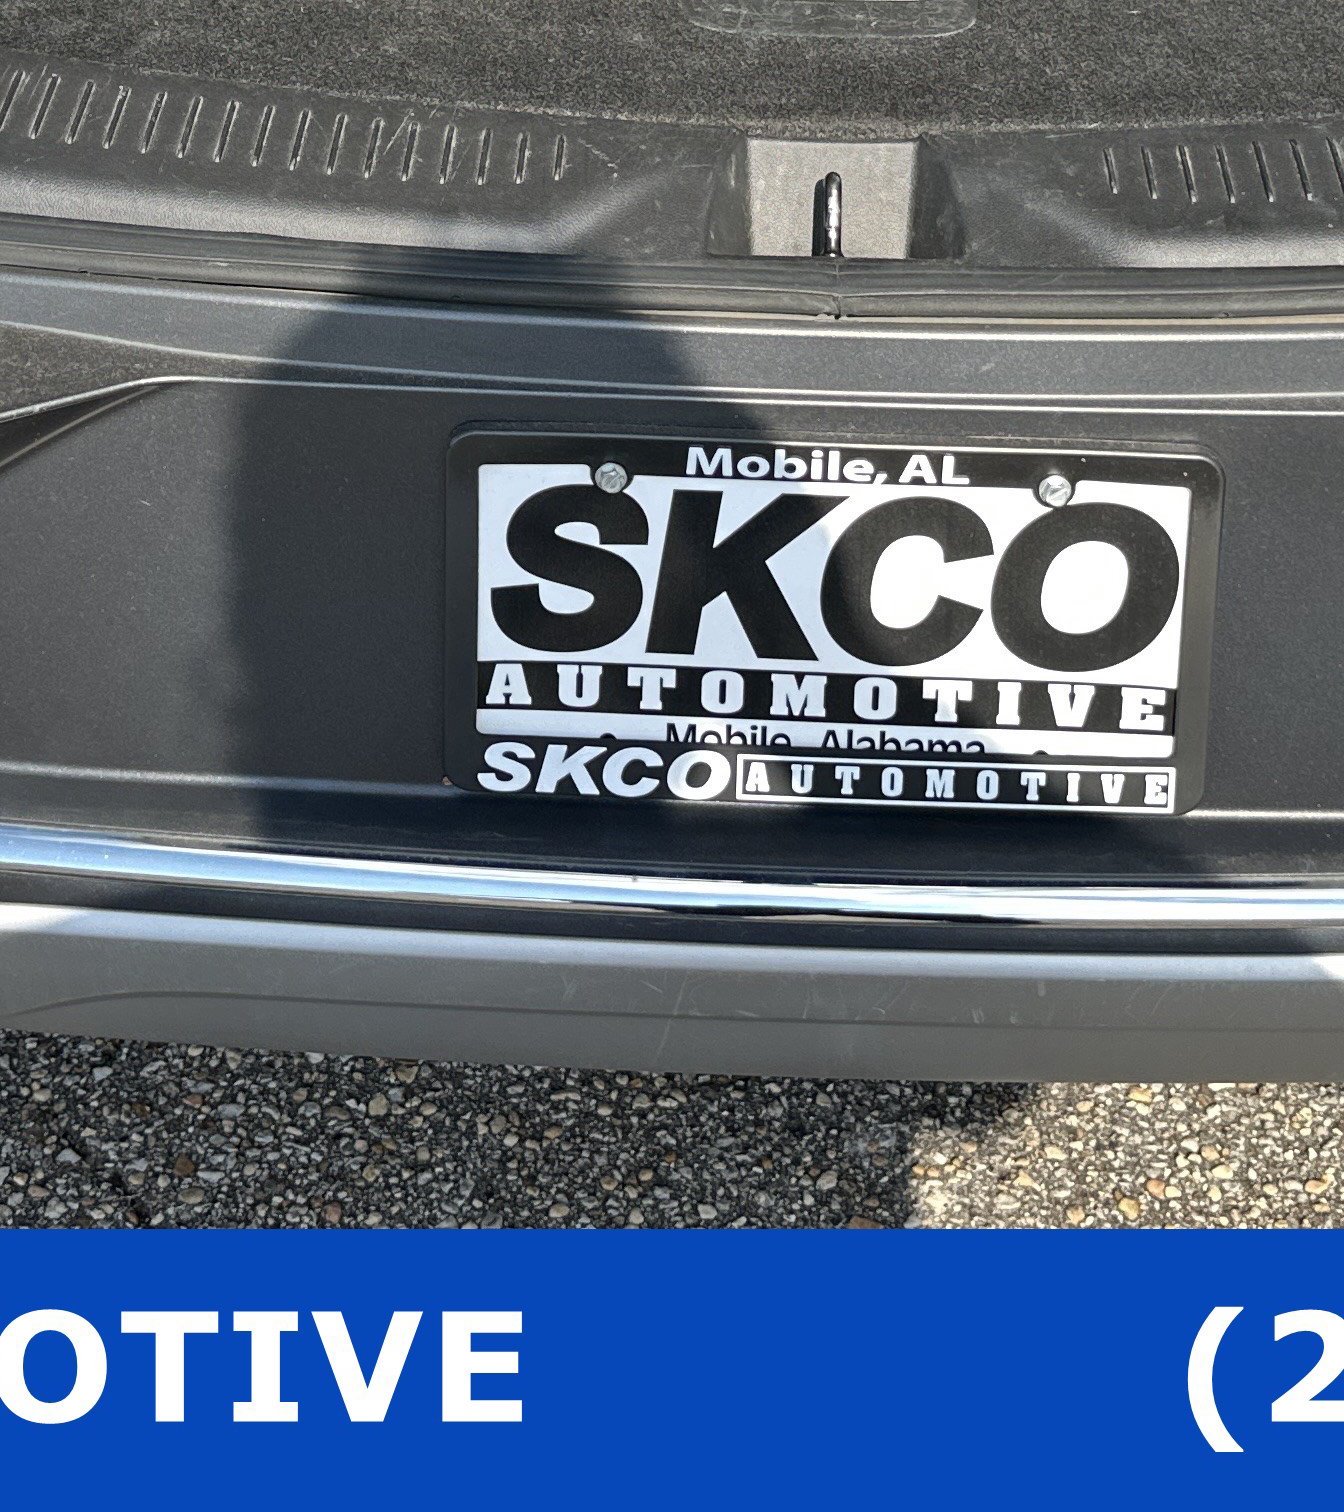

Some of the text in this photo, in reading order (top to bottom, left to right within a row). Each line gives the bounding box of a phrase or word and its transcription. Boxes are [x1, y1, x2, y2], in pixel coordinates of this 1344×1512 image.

[685, 446, 971, 486] Mobile, AL
[490, 483, 1180, 673] SKCO
[485, 662, 1166, 732] AUTOMOTIVE
[477, 741, 1169, 808] SKCO AUTOMOTIVE
